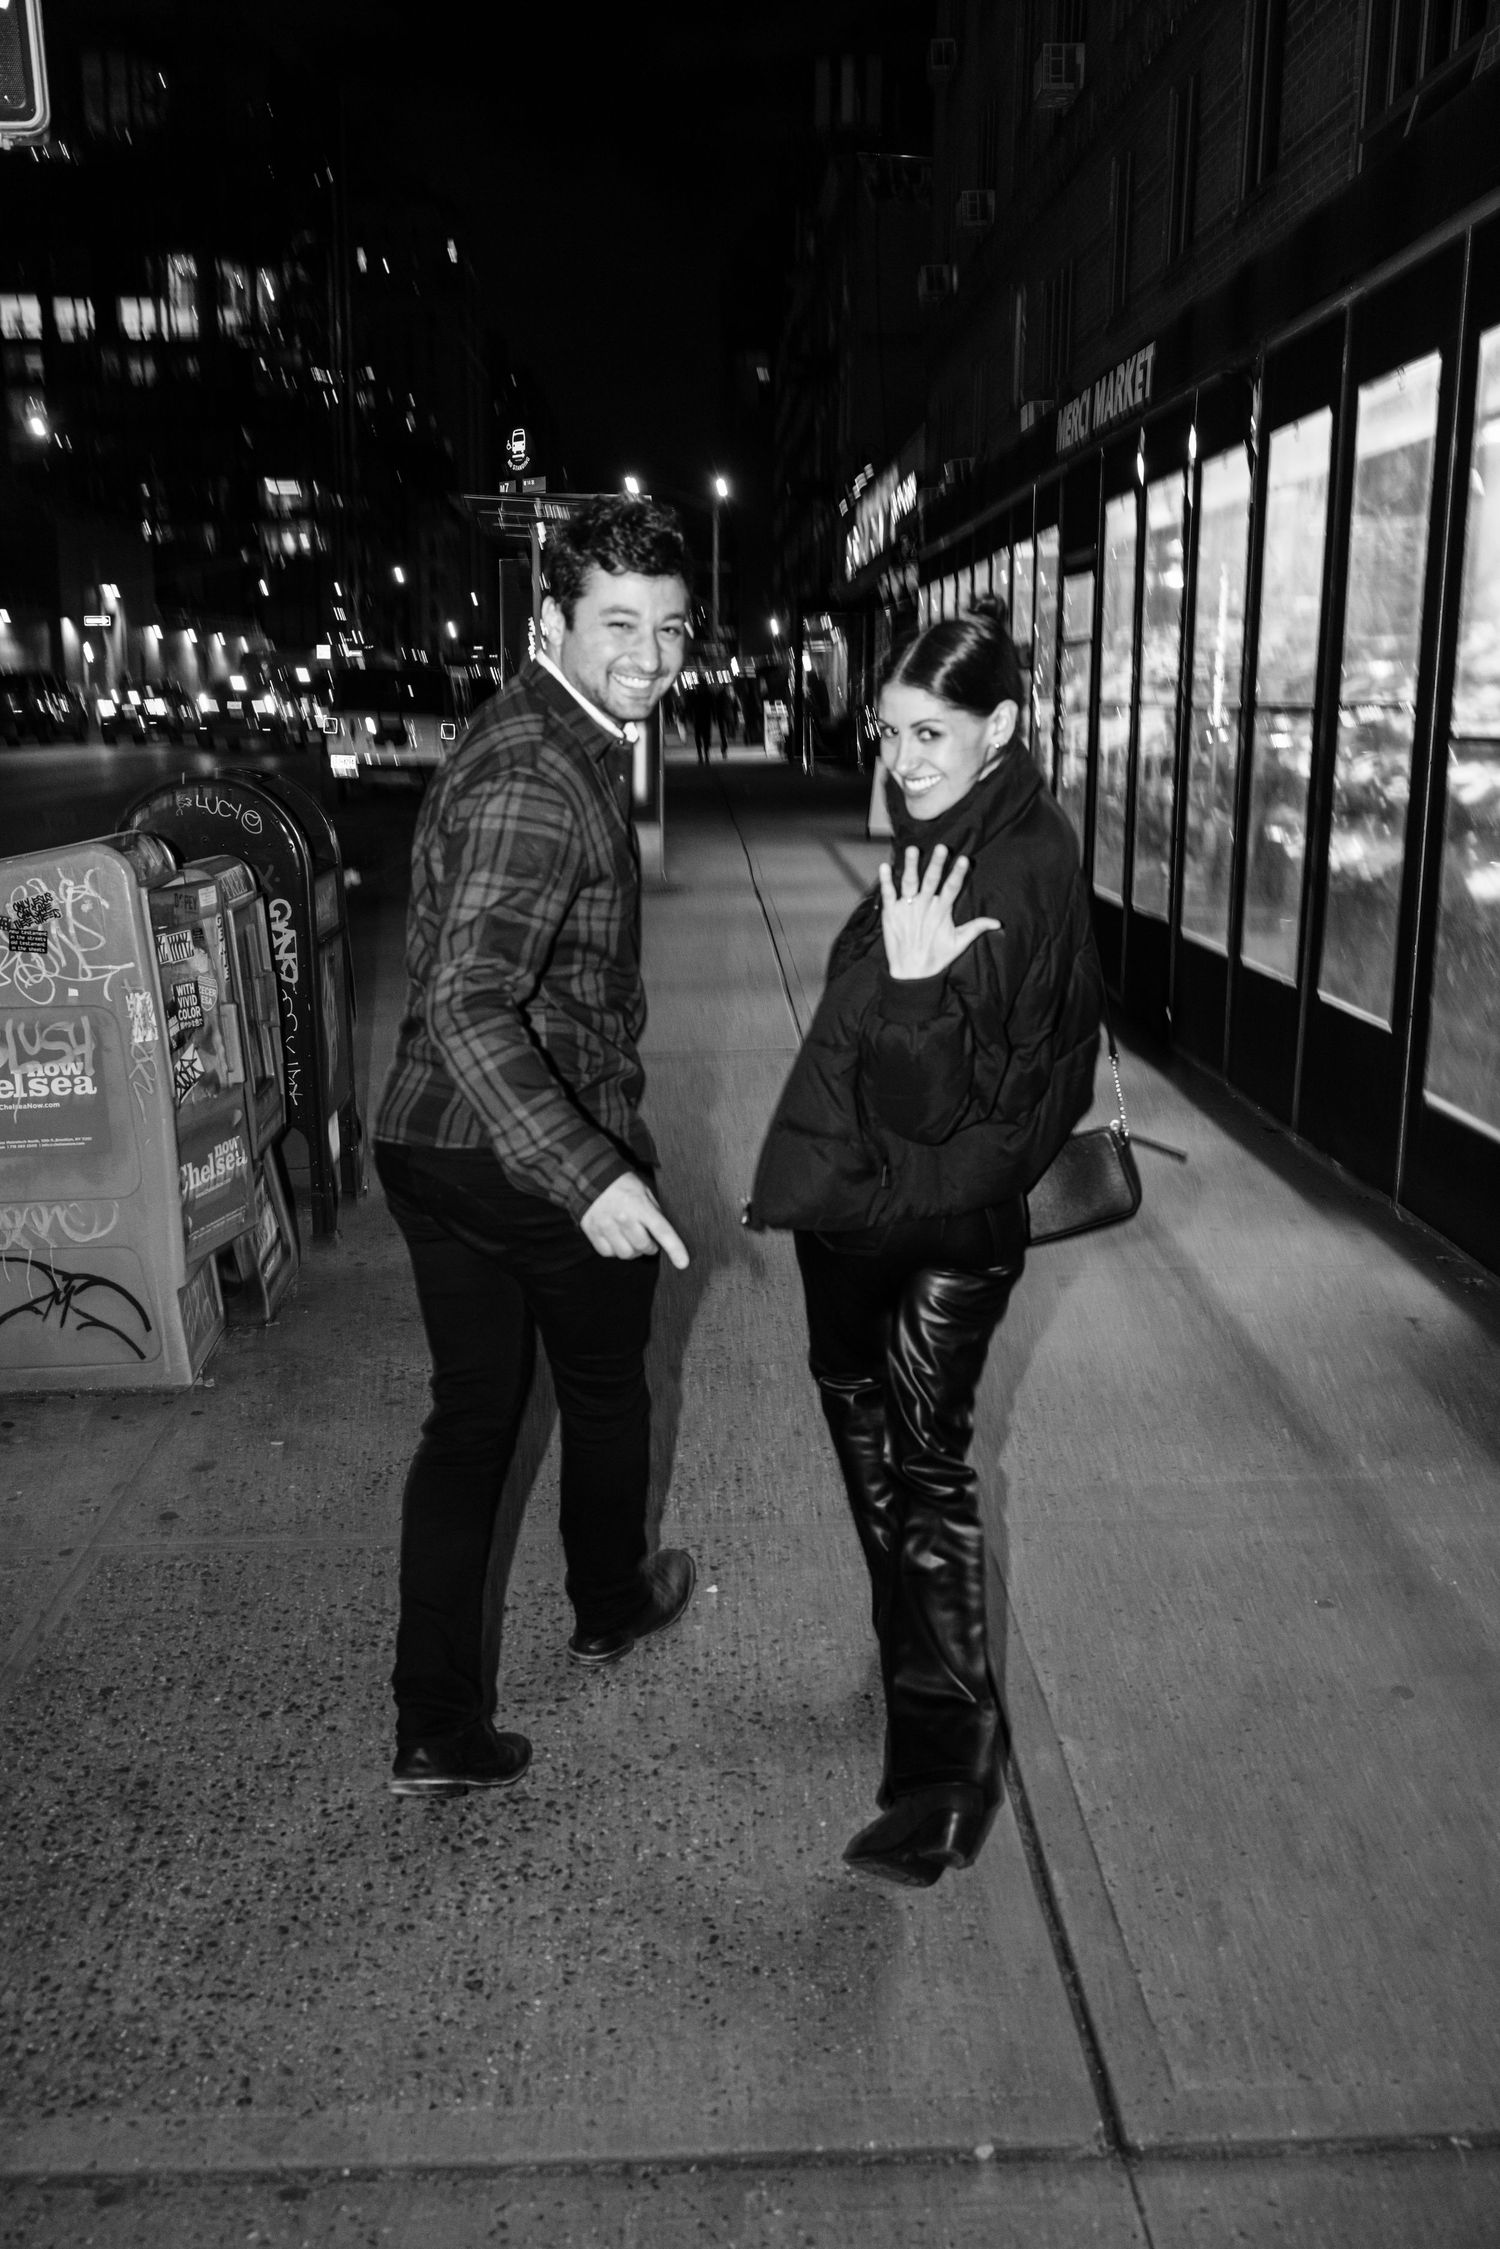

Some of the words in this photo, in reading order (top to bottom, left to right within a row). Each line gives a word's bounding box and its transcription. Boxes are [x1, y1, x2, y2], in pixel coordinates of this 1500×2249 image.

[1056, 387, 1092, 454] MERCI
[1092, 340, 1156, 431] MARKET
[196, 794, 242, 820] LUCY
[176, 983, 196, 997] WITH
[177, 995, 198, 1008] VIVID
[178, 1006, 202, 1021] COLOR
[27, 1061, 85, 1078] now
